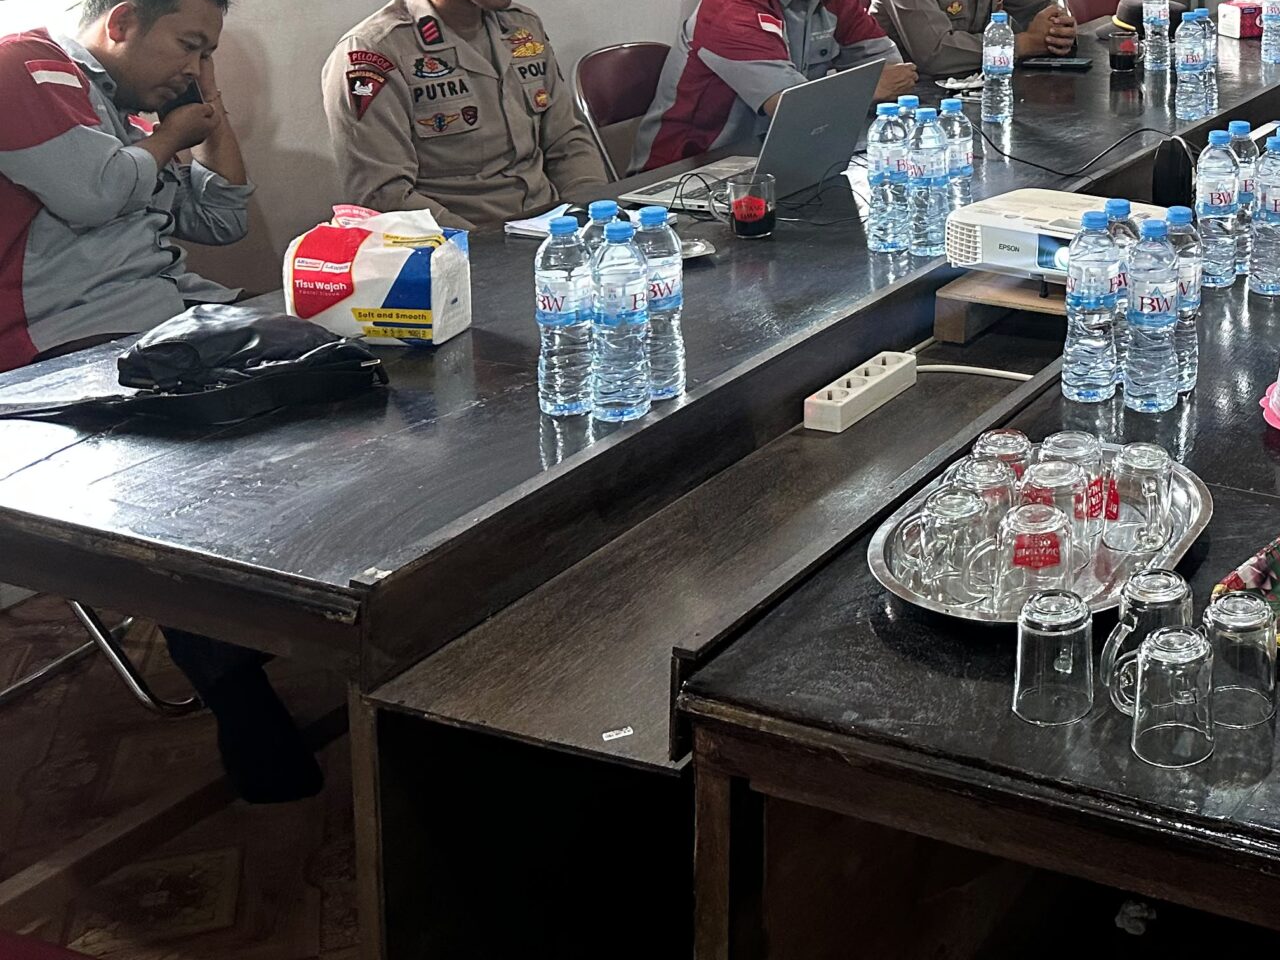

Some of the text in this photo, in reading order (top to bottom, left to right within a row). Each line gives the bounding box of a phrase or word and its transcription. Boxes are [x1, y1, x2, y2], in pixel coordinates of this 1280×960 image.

[413, 79, 469, 103] PUTRA
[1209, 190, 1235, 206] BW
[998, 244, 1020, 253] EPSON
[294, 279, 347, 292] Tisu Wajah
[649, 279, 676, 299] BW
[1138, 295, 1174, 313] BW
[358, 311, 427, 322] Soft and Smooth
